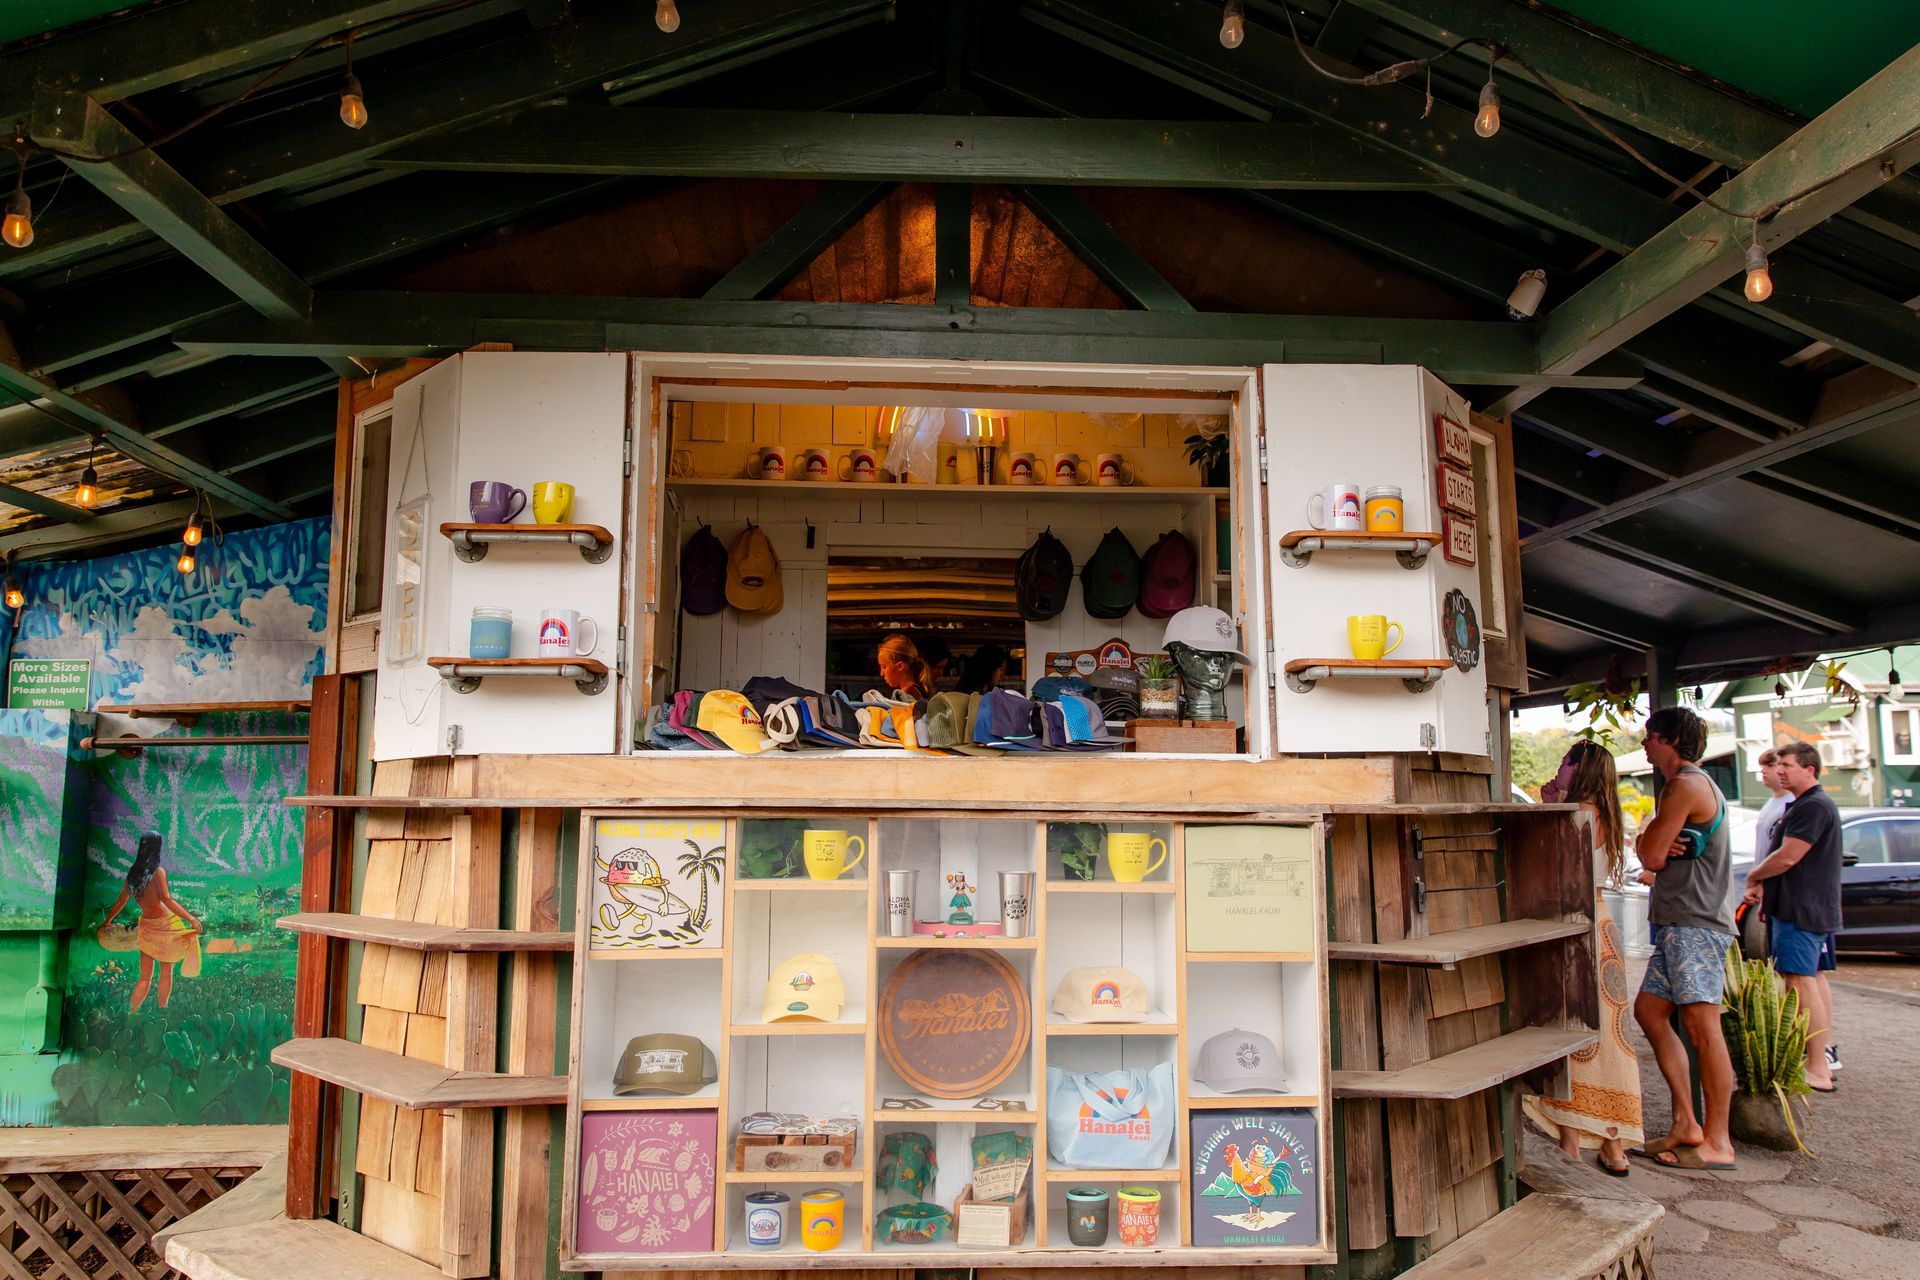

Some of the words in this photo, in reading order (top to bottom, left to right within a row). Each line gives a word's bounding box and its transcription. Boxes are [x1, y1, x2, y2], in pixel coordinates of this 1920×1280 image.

[1448, 476, 1473, 506] STARTS
[1454, 528, 1472, 554] HERE
[1452, 594, 1466, 614] NO
[1451, 645, 1477, 665] PLASTIC
[13, 662, 48, 672] More
[52, 662, 87, 672] Sizes
[18, 673, 81, 683] Available
[12, 686, 47, 694] Please
[50, 686, 85, 695] Inquire
[32, 698, 65, 707] Within
[599, 820, 641, 838] ALOHA
[644, 822, 688, 839] STARTS
[691, 823, 723, 839] HERE
[1259, 906, 1281, 915] KAUAI
[902, 1003, 1009, 1039] Hanalei
[1078, 1119, 1151, 1134] Hanalei
[1194, 1124, 1231, 1176] WISHING
[1231, 1116, 1265, 1131] WELL
[1268, 1121, 1305, 1154] SHAVE
[1298, 1154, 1314, 1175] ICE
[617, 1168, 679, 1198] HANALEI
